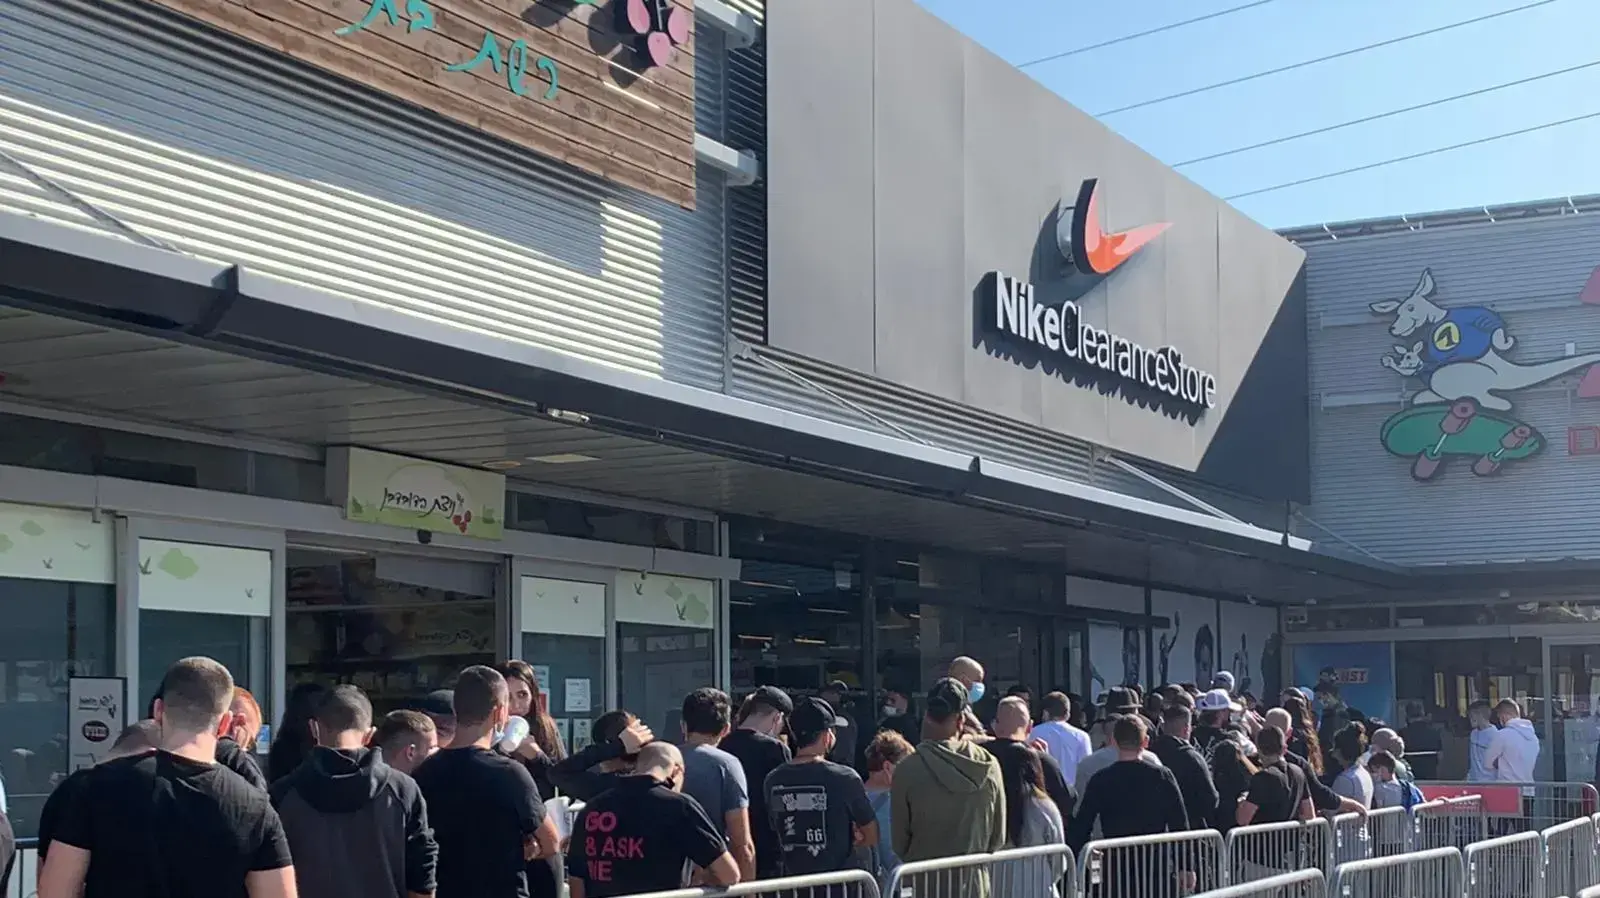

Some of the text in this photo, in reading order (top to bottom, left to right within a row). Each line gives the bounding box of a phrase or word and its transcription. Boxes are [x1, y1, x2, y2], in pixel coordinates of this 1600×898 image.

[443, 31, 559, 100] רשת
[585, 811, 617, 832] GO
[585, 836, 645, 859] & ASK
